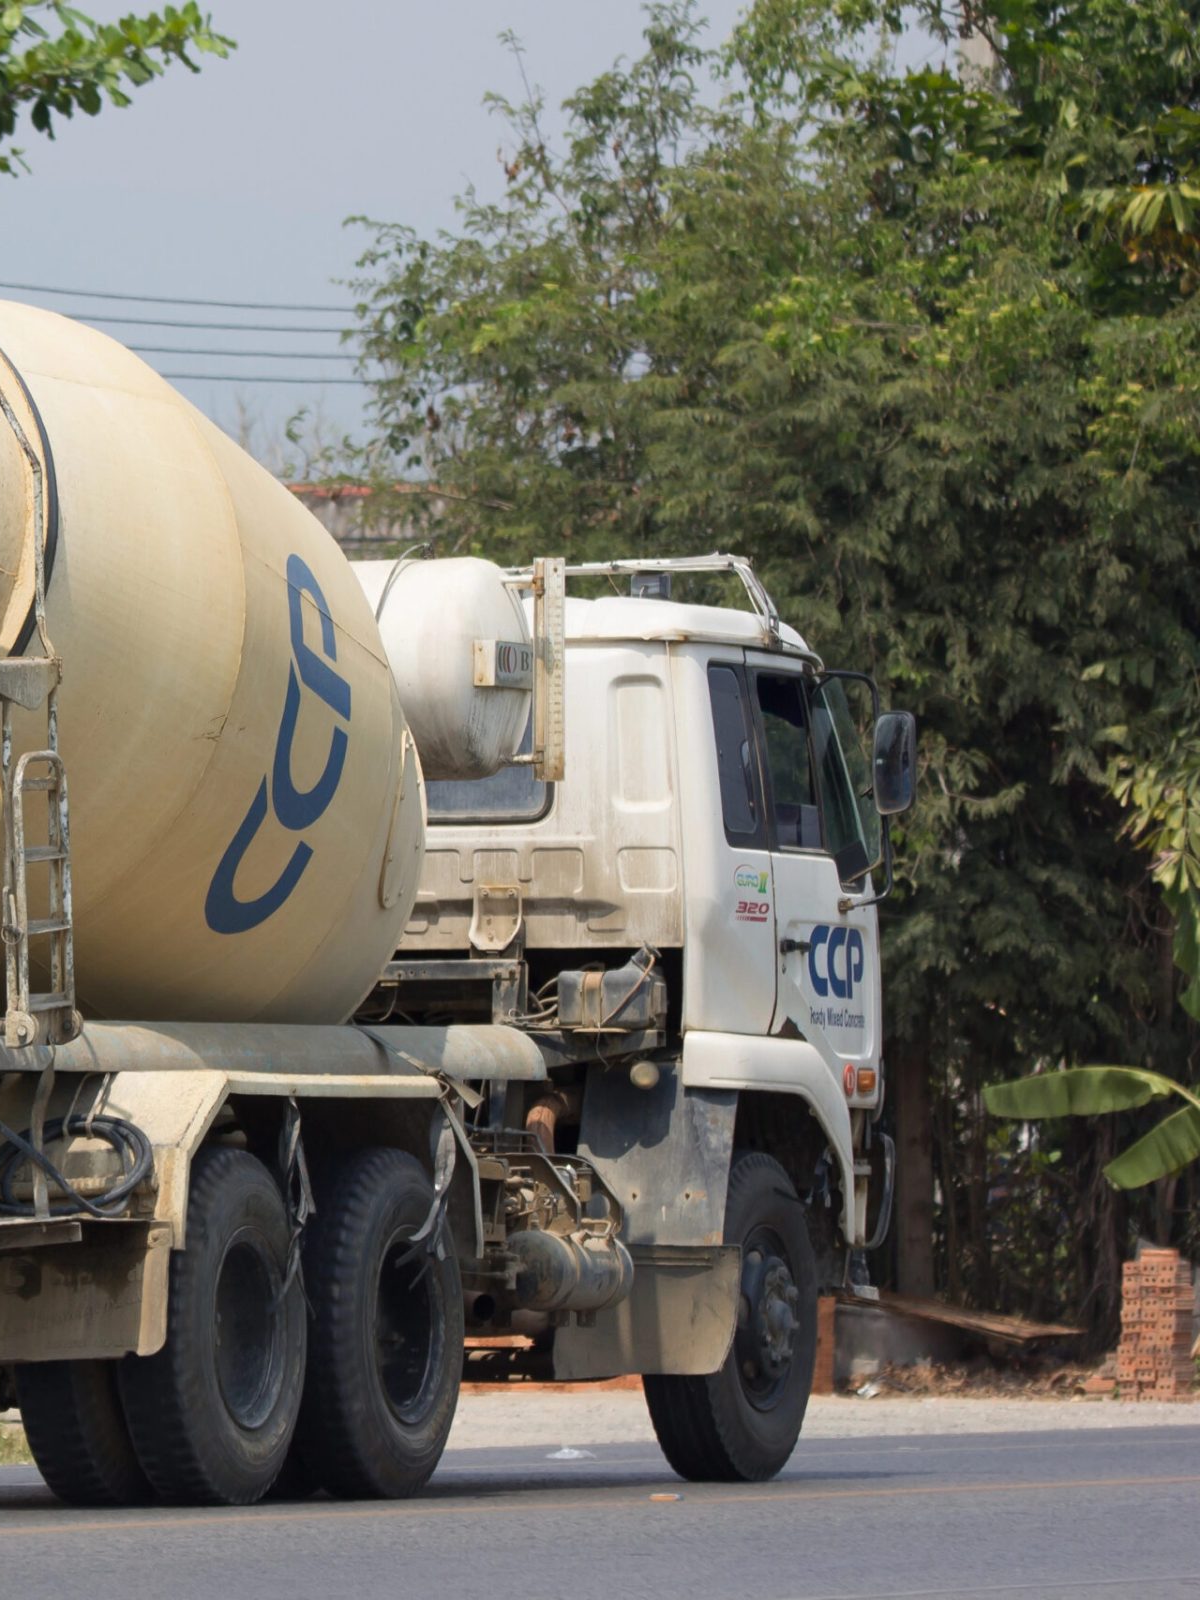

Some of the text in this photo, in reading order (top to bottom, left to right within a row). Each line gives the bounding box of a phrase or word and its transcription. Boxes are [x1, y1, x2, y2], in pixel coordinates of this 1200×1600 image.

[205, 553, 351, 934] CCP
[736, 901, 769, 914] 320
[808, 925, 864, 999] CCP
[827, 1007, 843, 1027] Mixed
